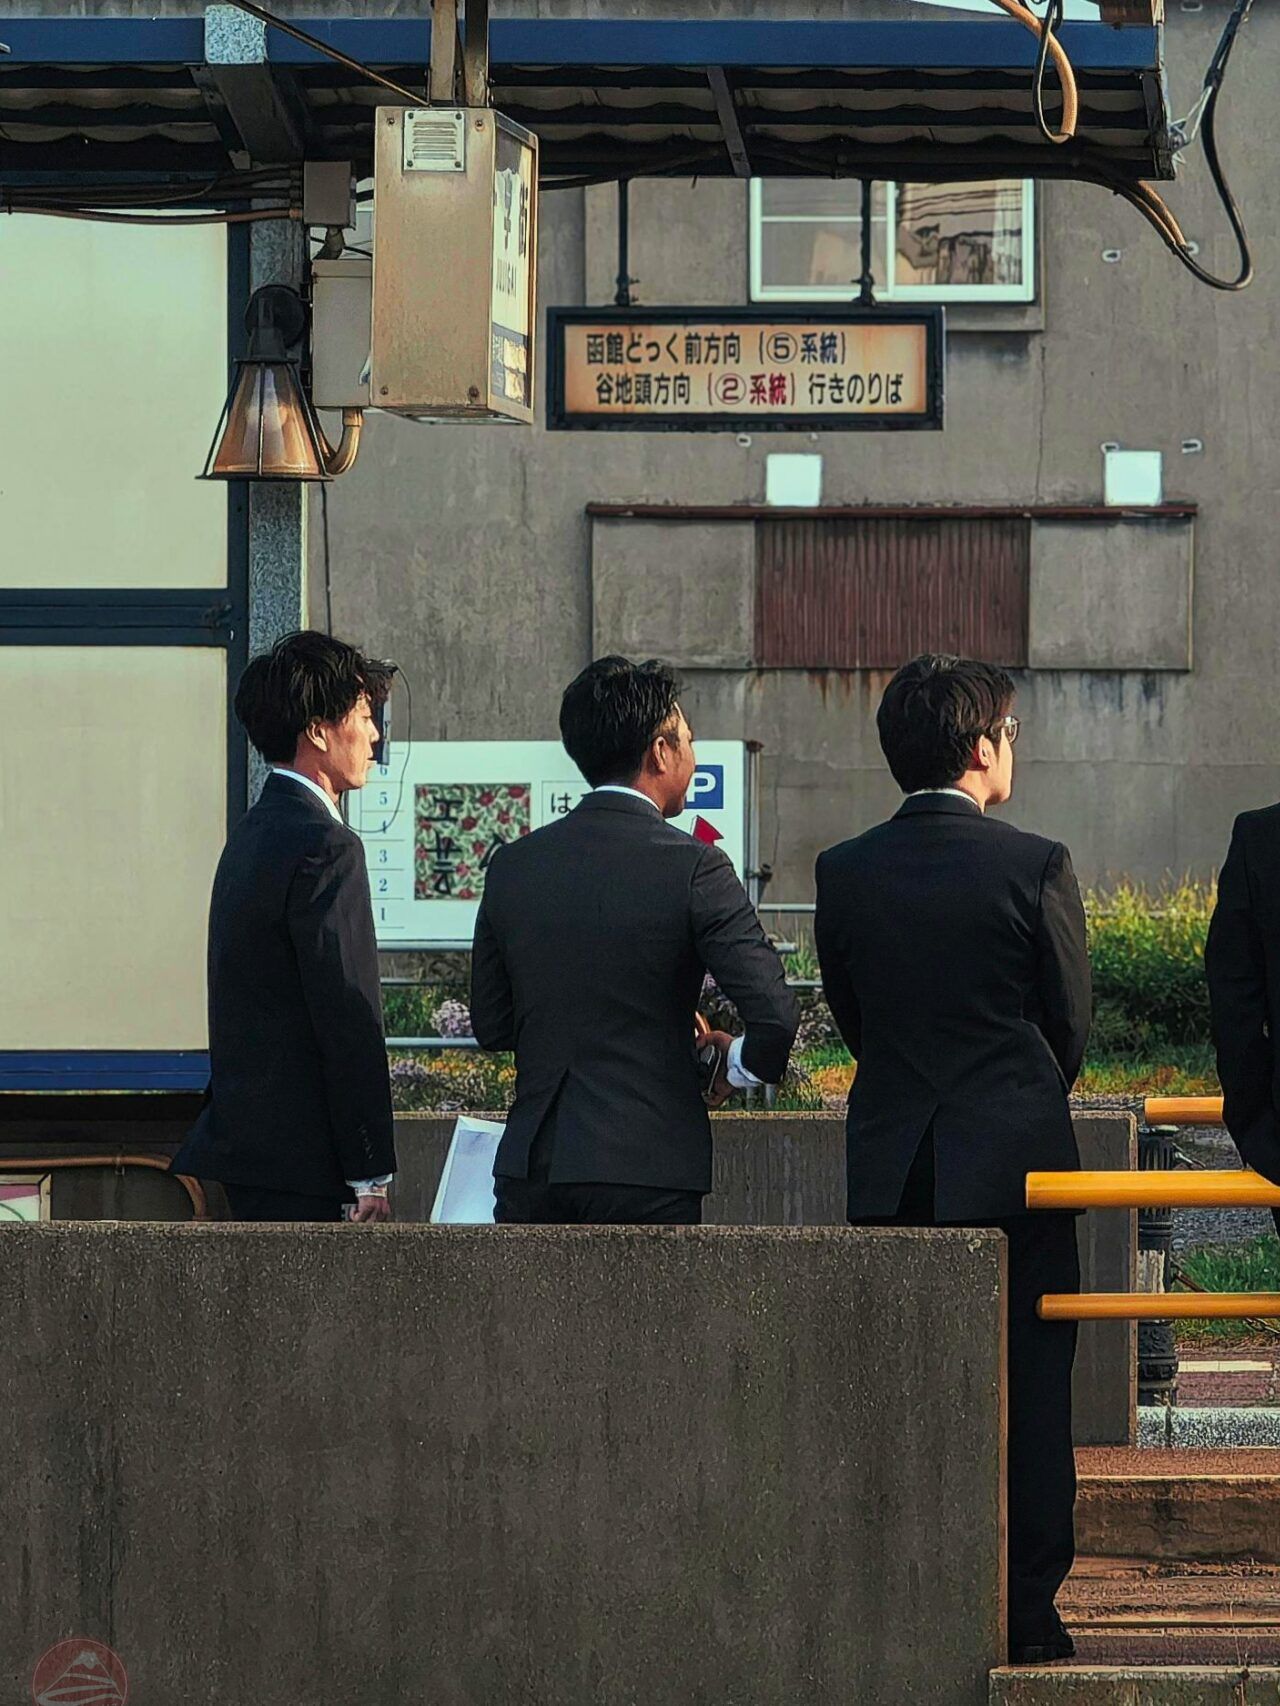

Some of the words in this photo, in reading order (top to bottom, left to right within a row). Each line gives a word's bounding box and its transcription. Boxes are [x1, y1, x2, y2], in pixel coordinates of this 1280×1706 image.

[686, 772, 716, 802] P
[379, 791, 388, 805] 5
[379, 849, 388, 863] 3
[379, 878, 388, 892] 2
[380, 907, 387, 921] 1
